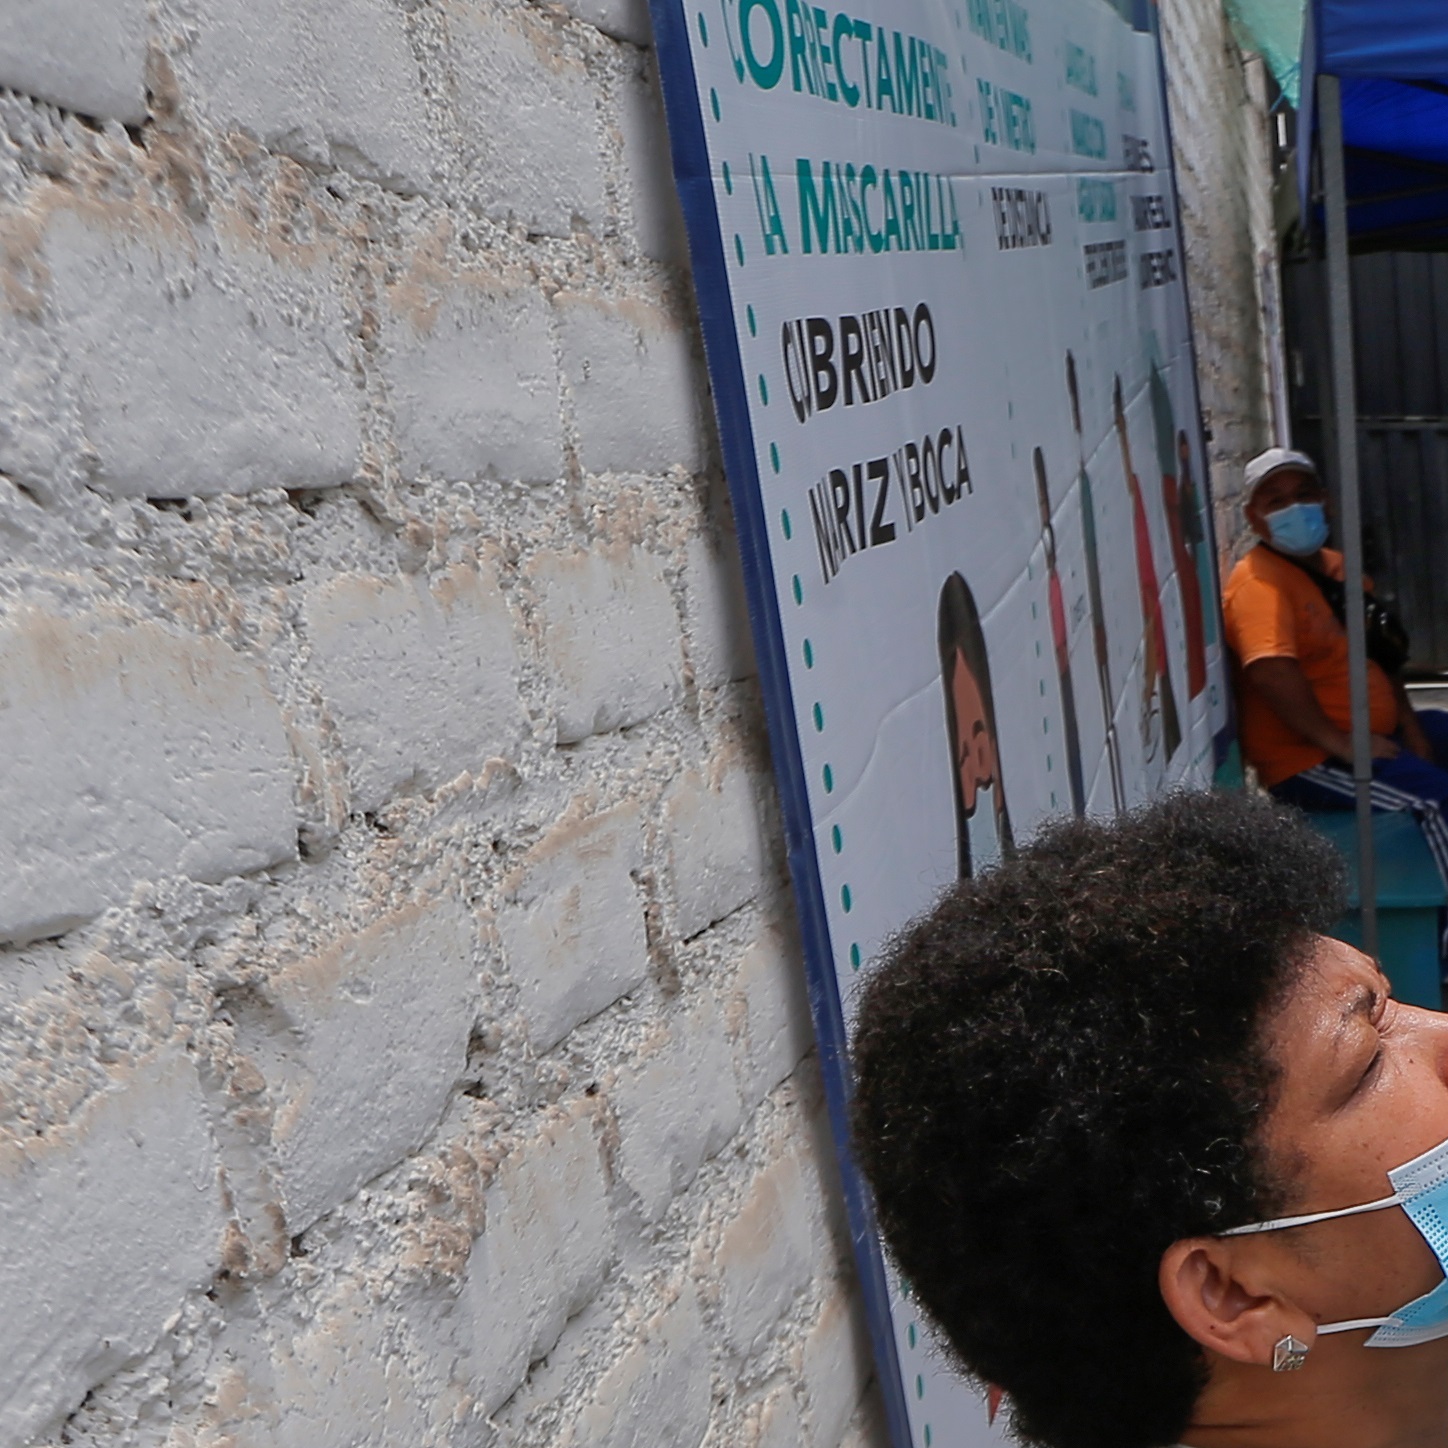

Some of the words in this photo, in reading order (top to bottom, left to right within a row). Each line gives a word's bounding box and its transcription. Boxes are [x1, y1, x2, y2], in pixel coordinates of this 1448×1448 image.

[748, 153, 789, 255] LA
[796, 158, 964, 256] MASCARILLA
[781, 303, 936, 423] CUBRIENDO
[808, 457, 896, 584] NARIZ
[893, 448, 912, 532] Y
[904, 425, 973, 523] BOCA
